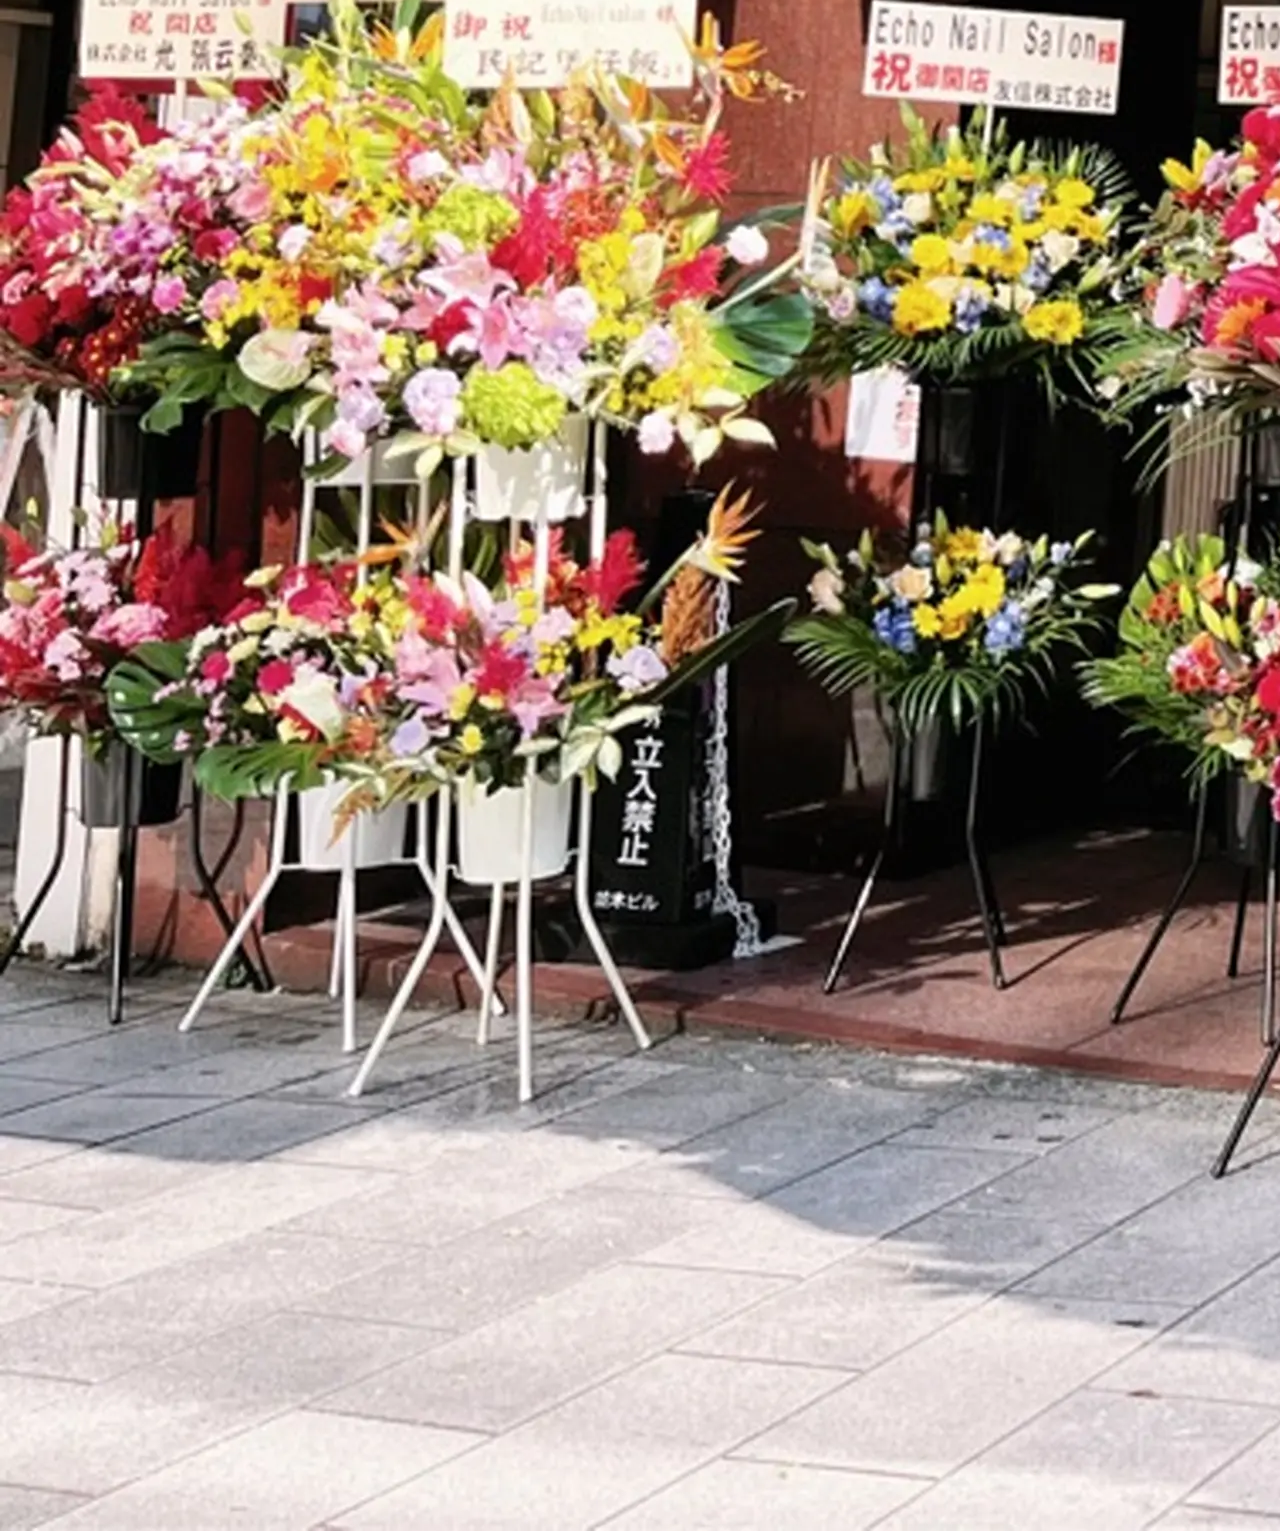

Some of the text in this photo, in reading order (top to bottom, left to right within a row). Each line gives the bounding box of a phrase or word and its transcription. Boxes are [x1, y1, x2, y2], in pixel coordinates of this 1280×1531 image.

[873, 7, 934, 48] Echo
[949, 13, 1006, 55] Nail
[1023, 19, 1097, 62] Salon
[615, 734, 665, 867] 立入禁止
